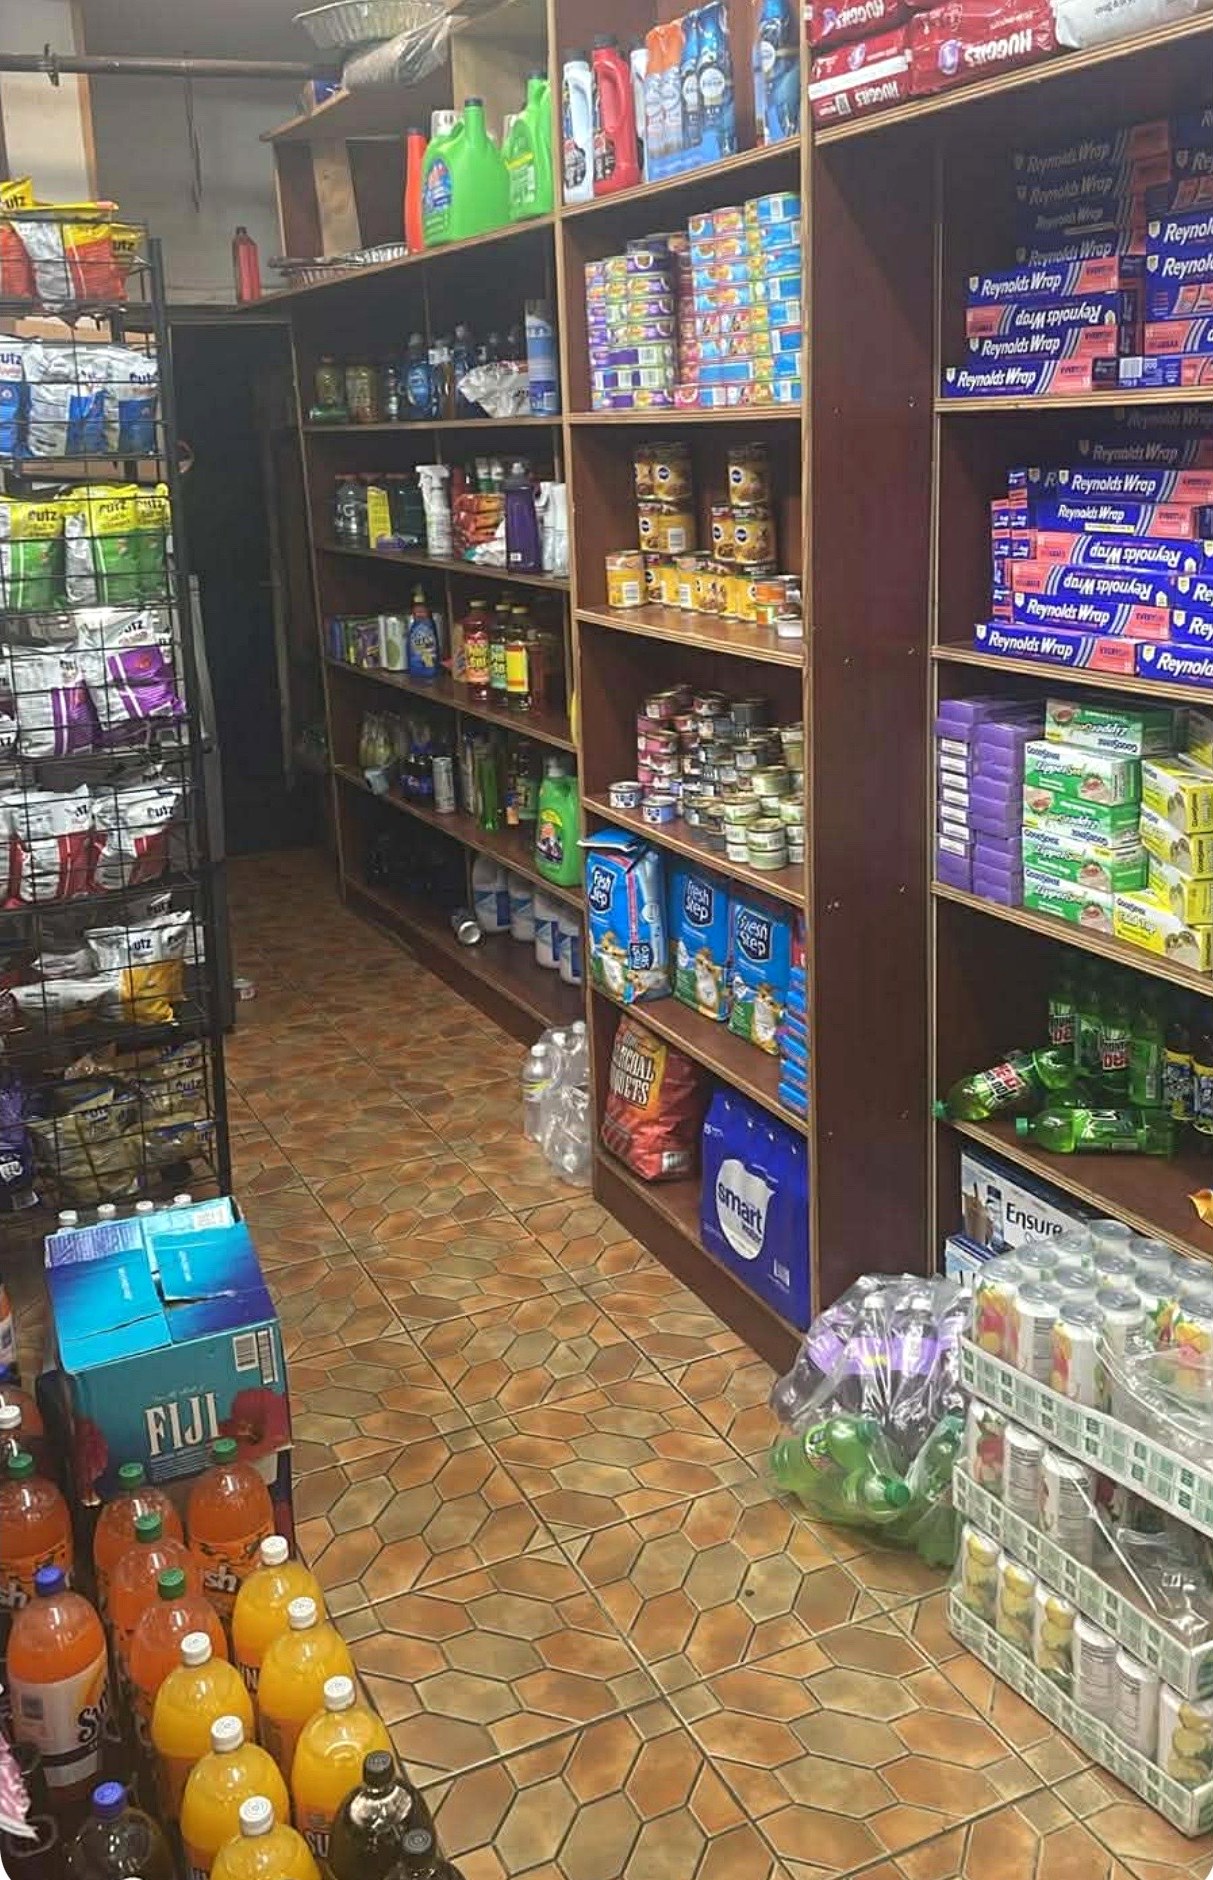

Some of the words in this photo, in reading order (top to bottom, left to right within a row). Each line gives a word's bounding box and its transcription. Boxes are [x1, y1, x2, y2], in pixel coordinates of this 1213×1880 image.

[964, 28, 1032, 67] HUGGIES
[1080, 174, 1112, 194] Wrap
[1079, 239, 1111, 258] Wrap
[981, 276, 1029, 299] Reynolds
[1030, 271, 1061, 291] Wrap
[1016, 310, 1046, 330] Wrap
[1047, 302, 1102, 325] Reynolds
[981, 336, 1029, 360] Reynolds
[1030, 334, 1061, 354] Wrap
[957, 368, 1006, 392] Reynolds
[1005, 367, 1036, 387] Wrap
[1145, 442, 1178, 464] Wrap
[1072, 475, 1123, 495] Reynolds
[1123, 475, 1157, 497] Wrap
[1058, 505, 1098, 523] Reynolds
[1099, 506, 1125, 524] Wrap
[1089, 541, 1122, 564] Wrap
[1123, 545, 1182, 568] Reynolds
[1063, 573, 1095, 595] Wrap
[1096, 578, 1153, 601] Reynolds
[1027, 599, 1077, 624] Reynolds
[1077, 602, 1110, 628] Wrap
[989, 632, 1040, 657] Reynolds
[1040, 634, 1073, 660] Wrap
[688, 880, 709, 906] Fresh
[685, 896, 709, 921] Step
[738, 915, 768, 941] Fresh
[739, 930, 766, 957] Step
[717, 1182, 763, 1234] smart
[1006, 1202, 1063, 1237] Ensure
[145, 1392, 222, 1456] FIJI
